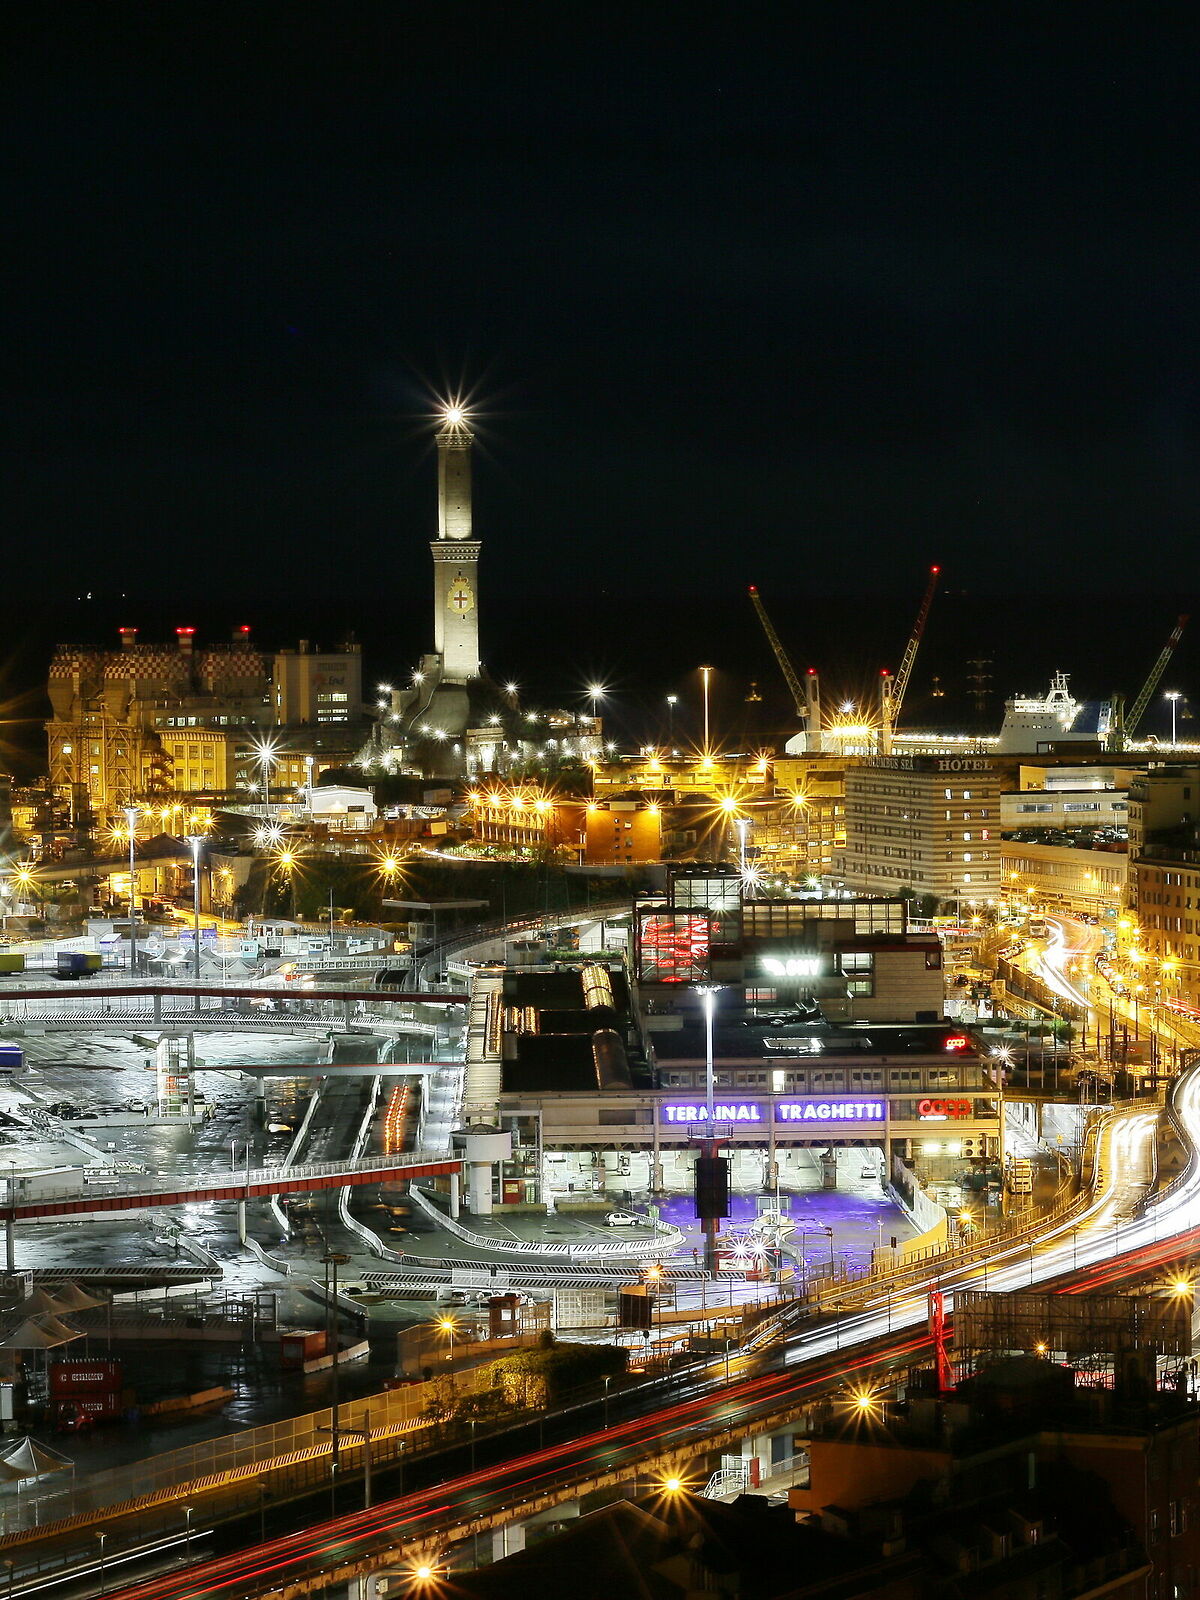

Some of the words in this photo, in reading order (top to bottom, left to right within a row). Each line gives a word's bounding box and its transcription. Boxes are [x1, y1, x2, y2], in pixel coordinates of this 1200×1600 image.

[863, 757, 899, 769] COLUMBUS
[900, 758, 914, 770] SEA
[938, 758, 993, 771] HOTEL
[665, 1104, 760, 1121] TERMINAL
[779, 1103, 882, 1121] TRAGHETTI
